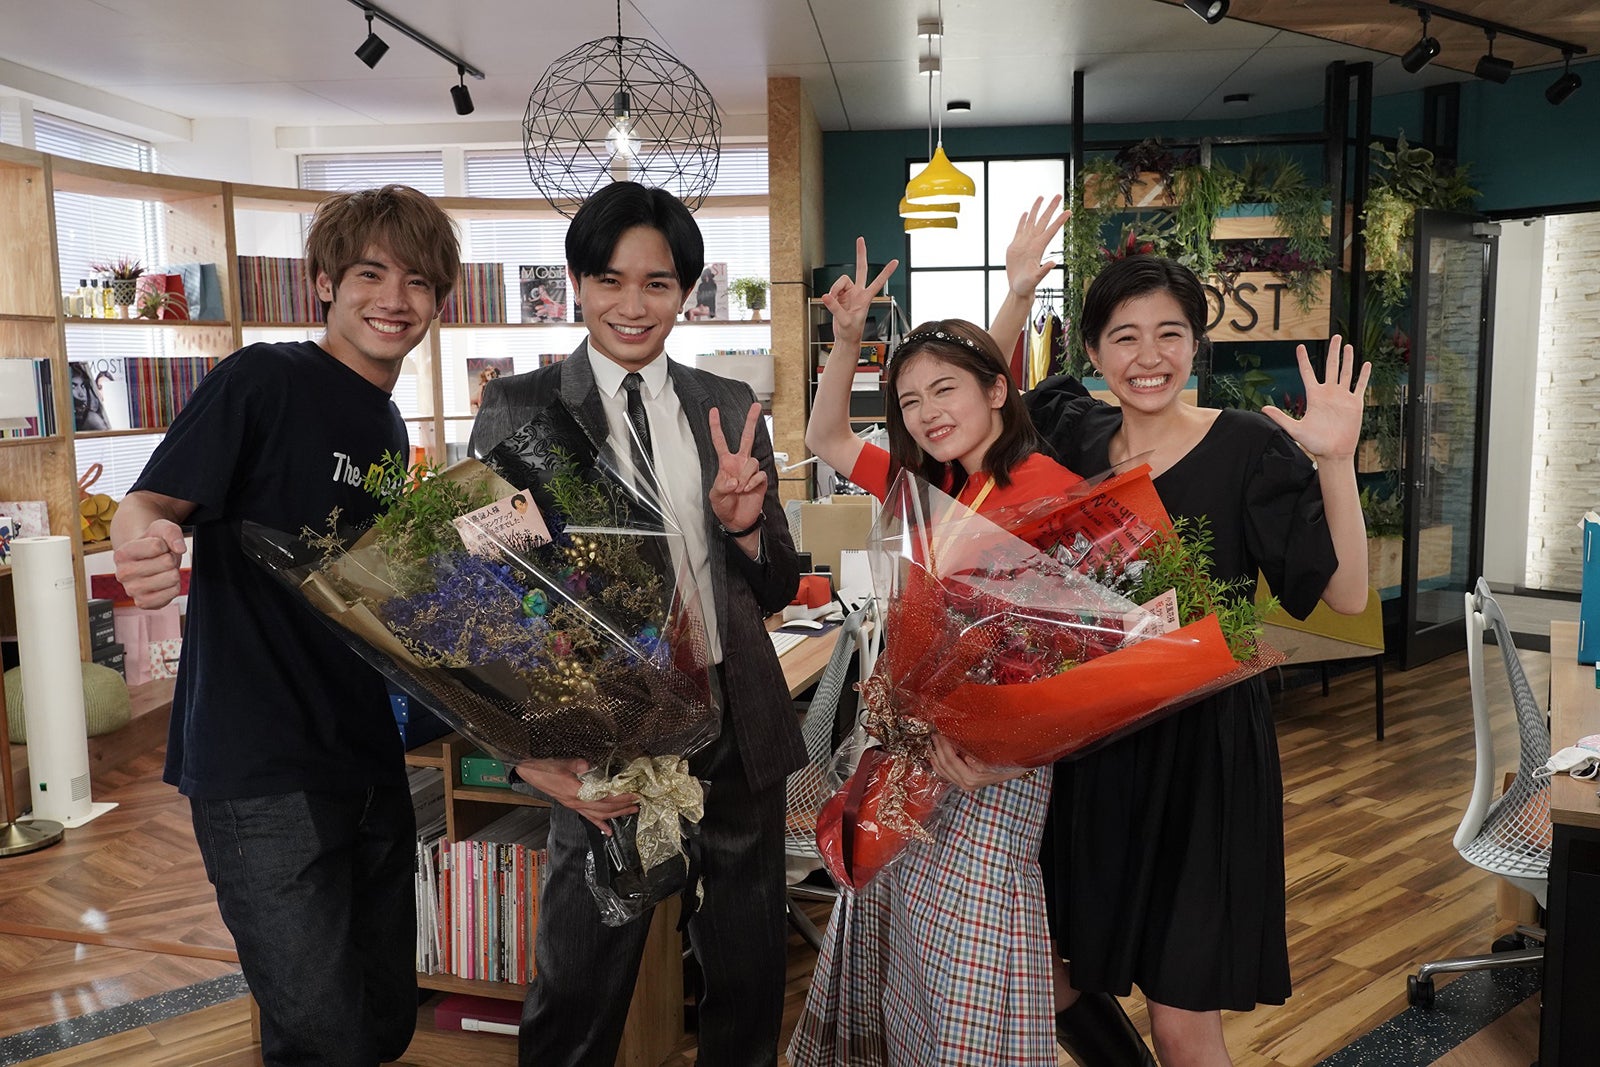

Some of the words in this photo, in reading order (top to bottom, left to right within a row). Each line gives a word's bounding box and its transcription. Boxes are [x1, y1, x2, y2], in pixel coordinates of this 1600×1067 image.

[520, 265, 565, 279] MOST
[1202, 282, 1288, 332] OST
[467, 359, 513, 371] MOST
[332, 451, 362, 488] The
